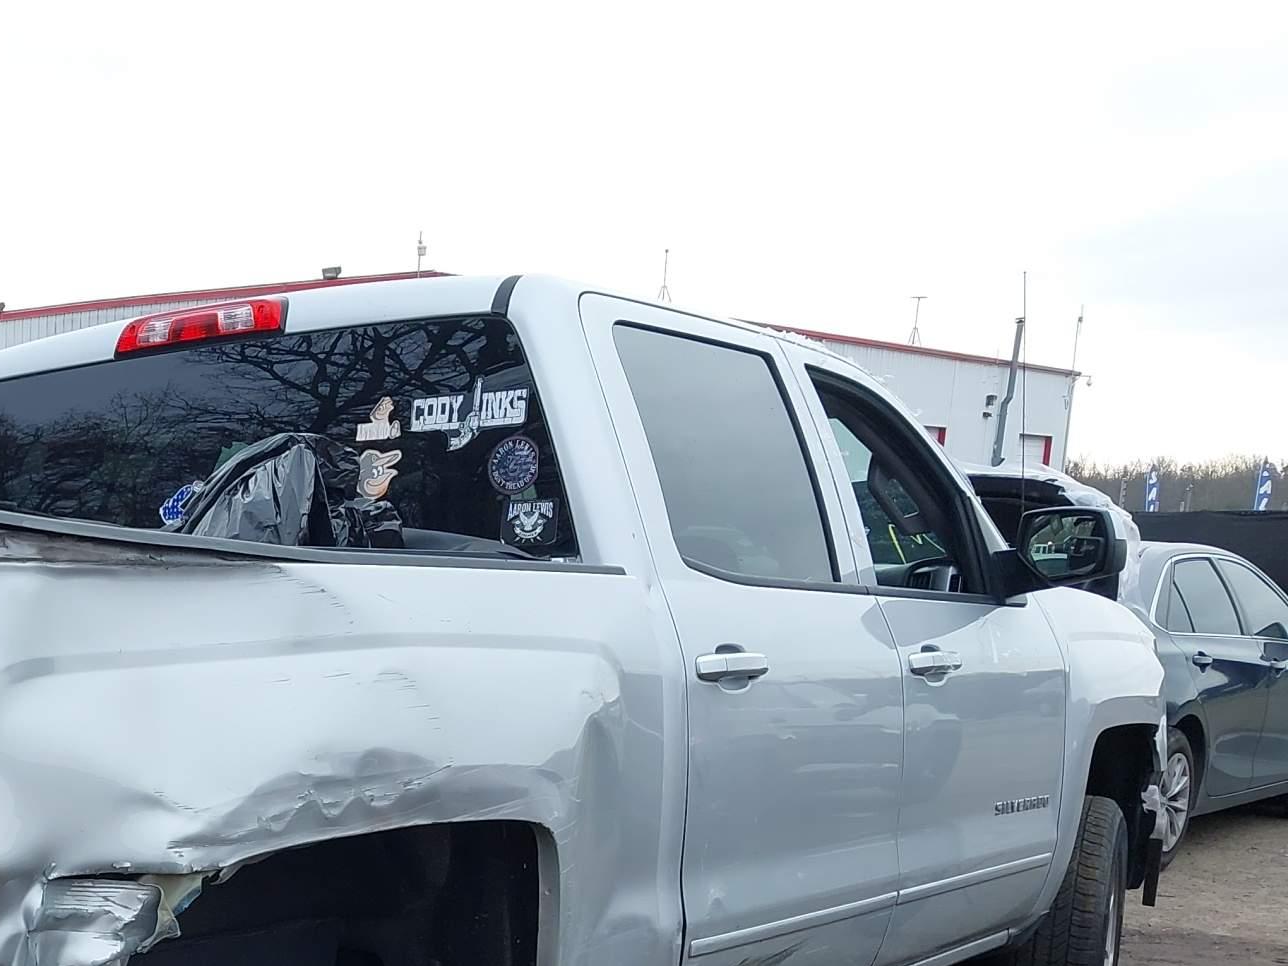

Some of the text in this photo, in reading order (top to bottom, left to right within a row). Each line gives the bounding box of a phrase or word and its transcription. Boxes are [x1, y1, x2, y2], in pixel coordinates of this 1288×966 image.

[411, 394, 464, 431] CODY
[492, 440, 514, 465] AARON
[506, 501, 554, 521] AARON LEWIS
